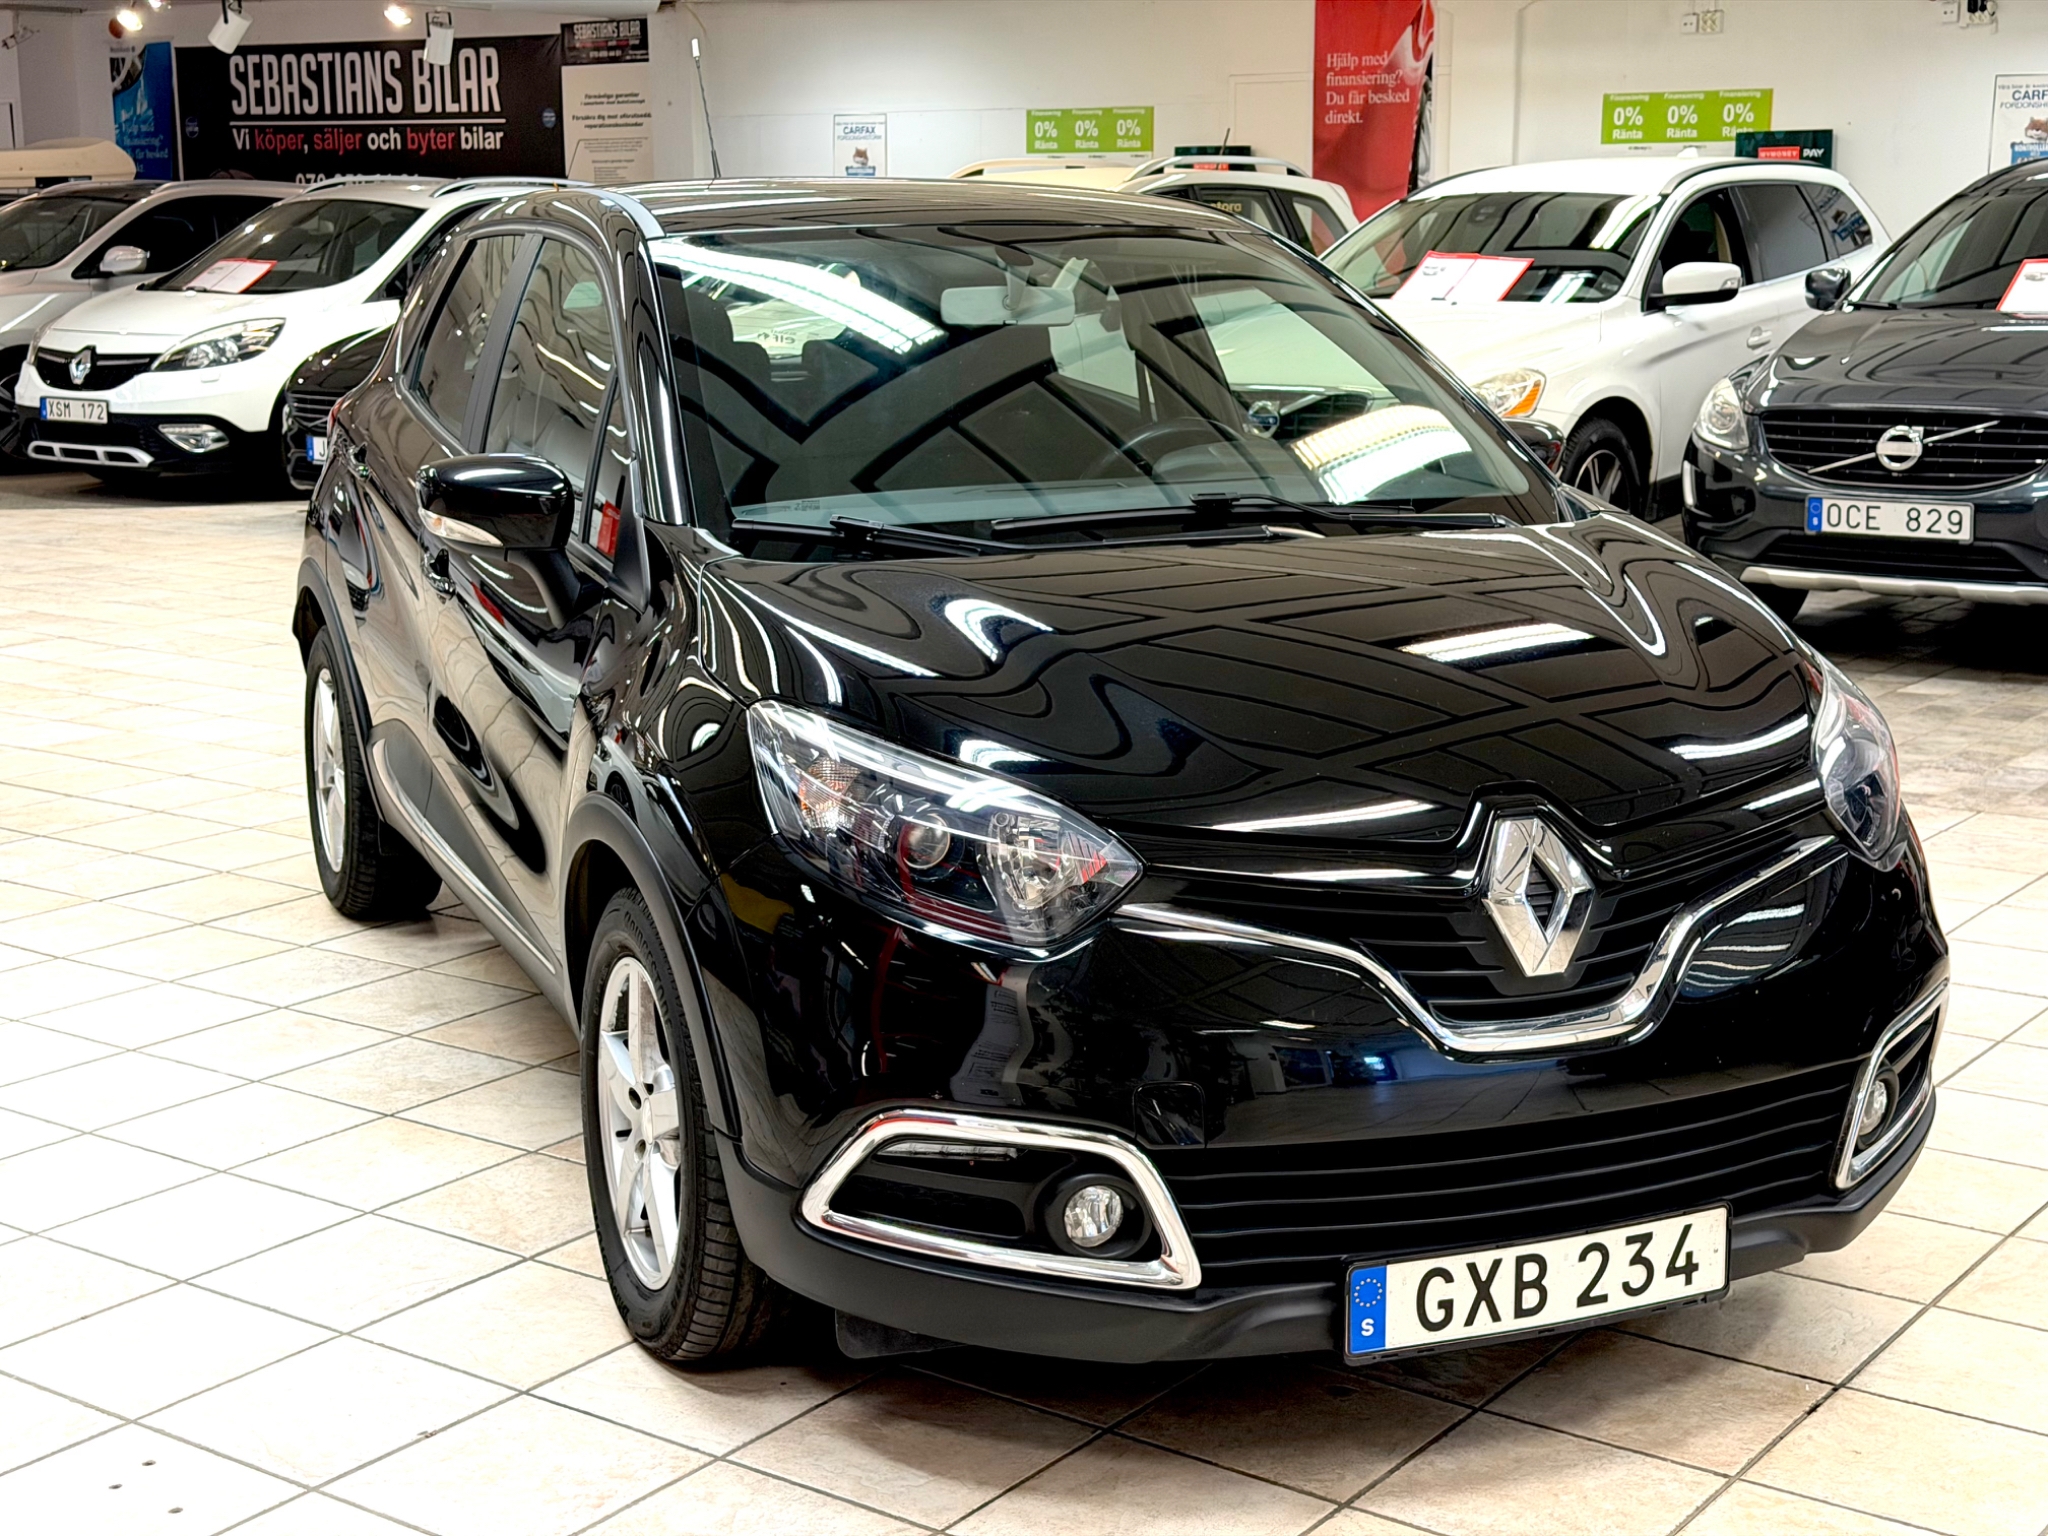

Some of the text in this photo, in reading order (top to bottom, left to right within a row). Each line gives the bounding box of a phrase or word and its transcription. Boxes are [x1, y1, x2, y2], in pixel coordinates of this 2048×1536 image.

[573, 20, 641, 39] SEBASTIANS BILAR
[1326, 51, 1388, 71] Hjälp med
[229, 47, 501, 115] SEBASTIANS BILAR
[1326, 69, 1403, 88] finansiering?
[1326, 88, 1410, 105] Du får besked
[1325, 109, 1363, 124] direkt.
[1613, 103, 1754, 126] 0% 0% 0%
[843, 126, 876, 135] CARFAX
[1034, 119, 1141, 138] 0% 0% 0%
[1612, 127, 1698, 140] Ränta Ränta
[232, 126, 504, 155] Vi köper, säljer och byter bilar
[1803, 148, 1825, 158] PAY
[48, 400, 104, 420] XSM 172
[1826, 503, 1963, 535] OCE 829
[1416, 1223, 1700, 1332] GXB 234
[1361, 1319, 1375, 1336] S
